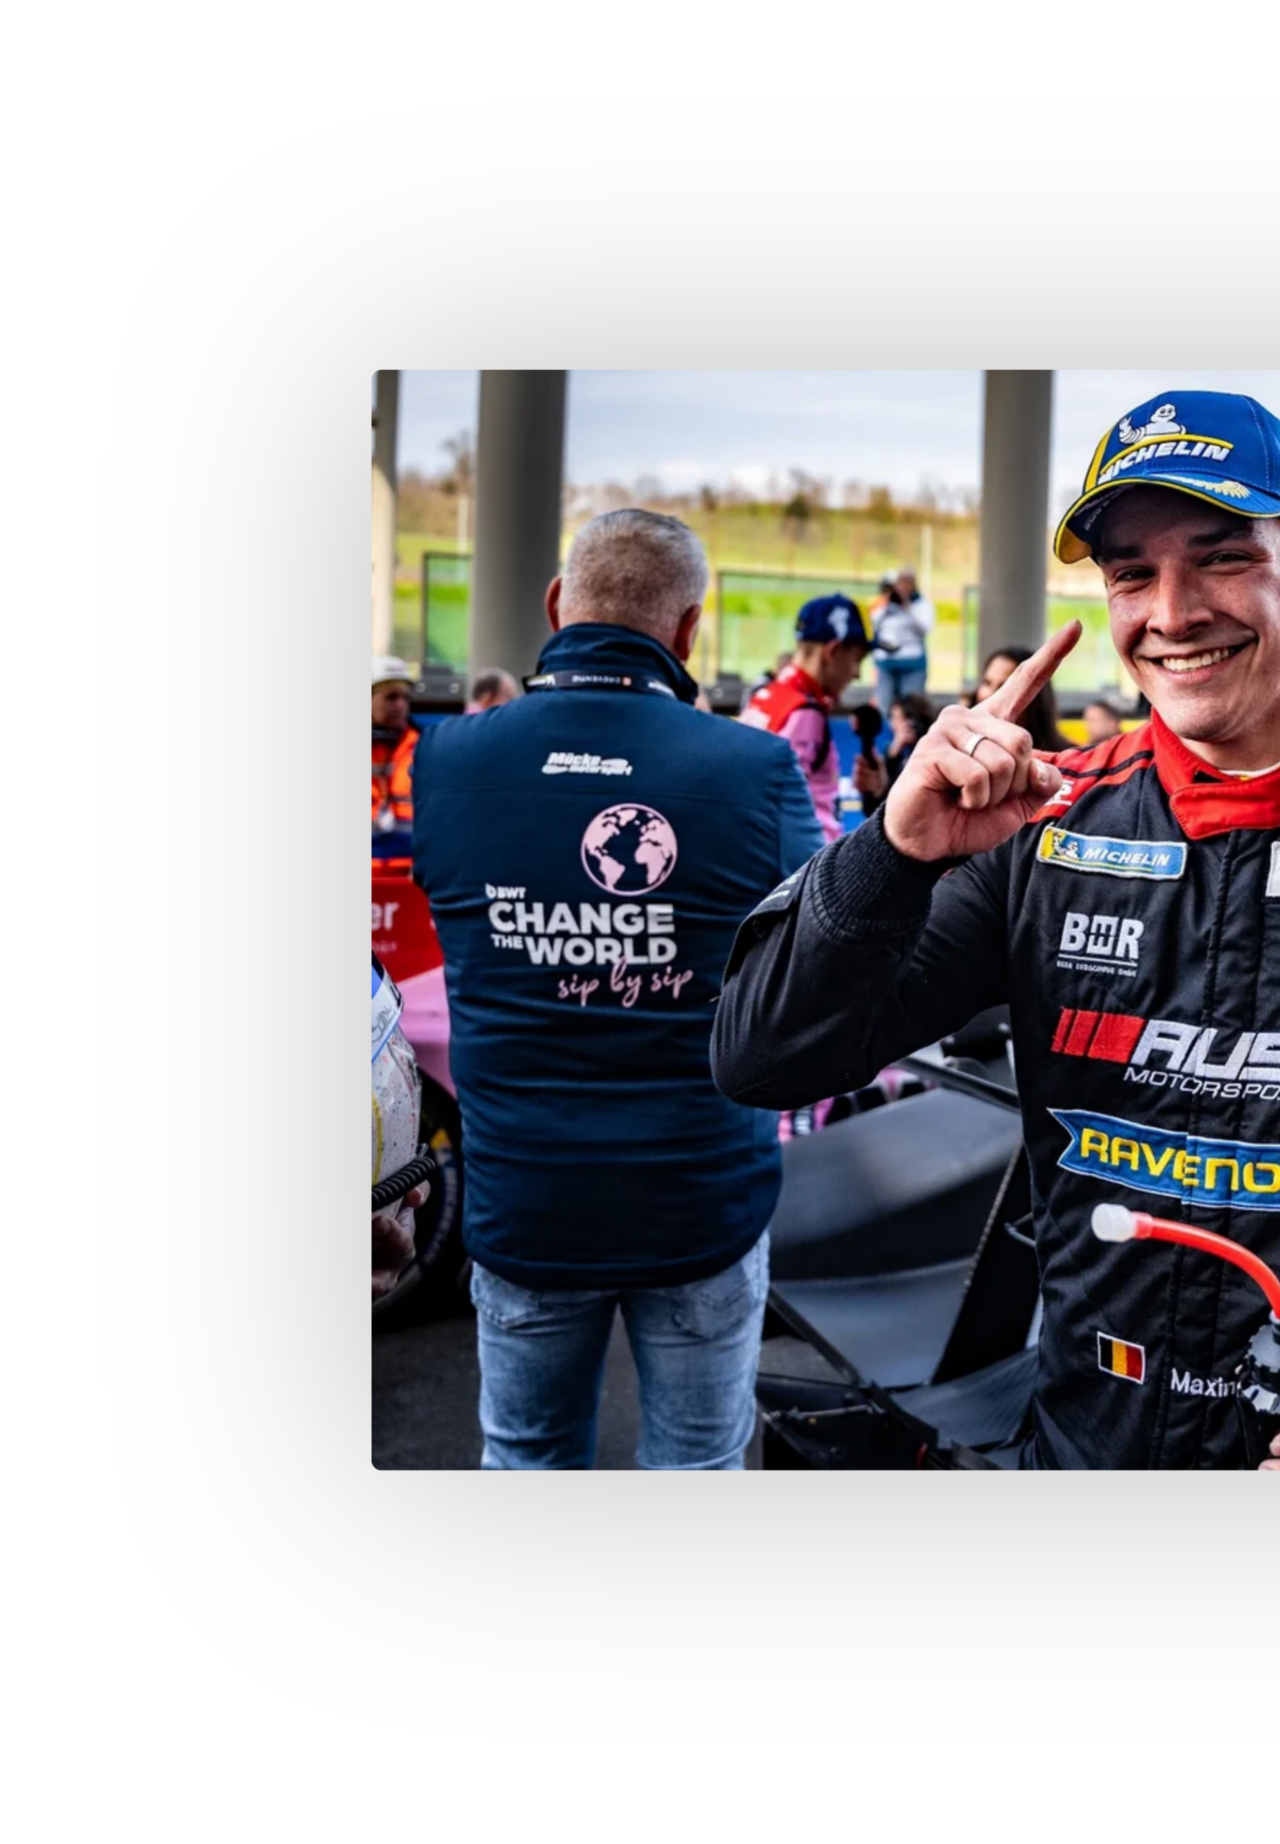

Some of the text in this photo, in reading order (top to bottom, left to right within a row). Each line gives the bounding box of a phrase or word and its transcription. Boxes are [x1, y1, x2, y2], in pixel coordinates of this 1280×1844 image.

[547, 752, 601, 768] Mücke
[1083, 848, 1170, 866] MICHELIN
[497, 886, 526, 899] BWT
[488, 901, 675, 935] CHANGE
[491, 934, 677, 965] THE WORLD
[558, 956, 693, 1008] sip by sip
